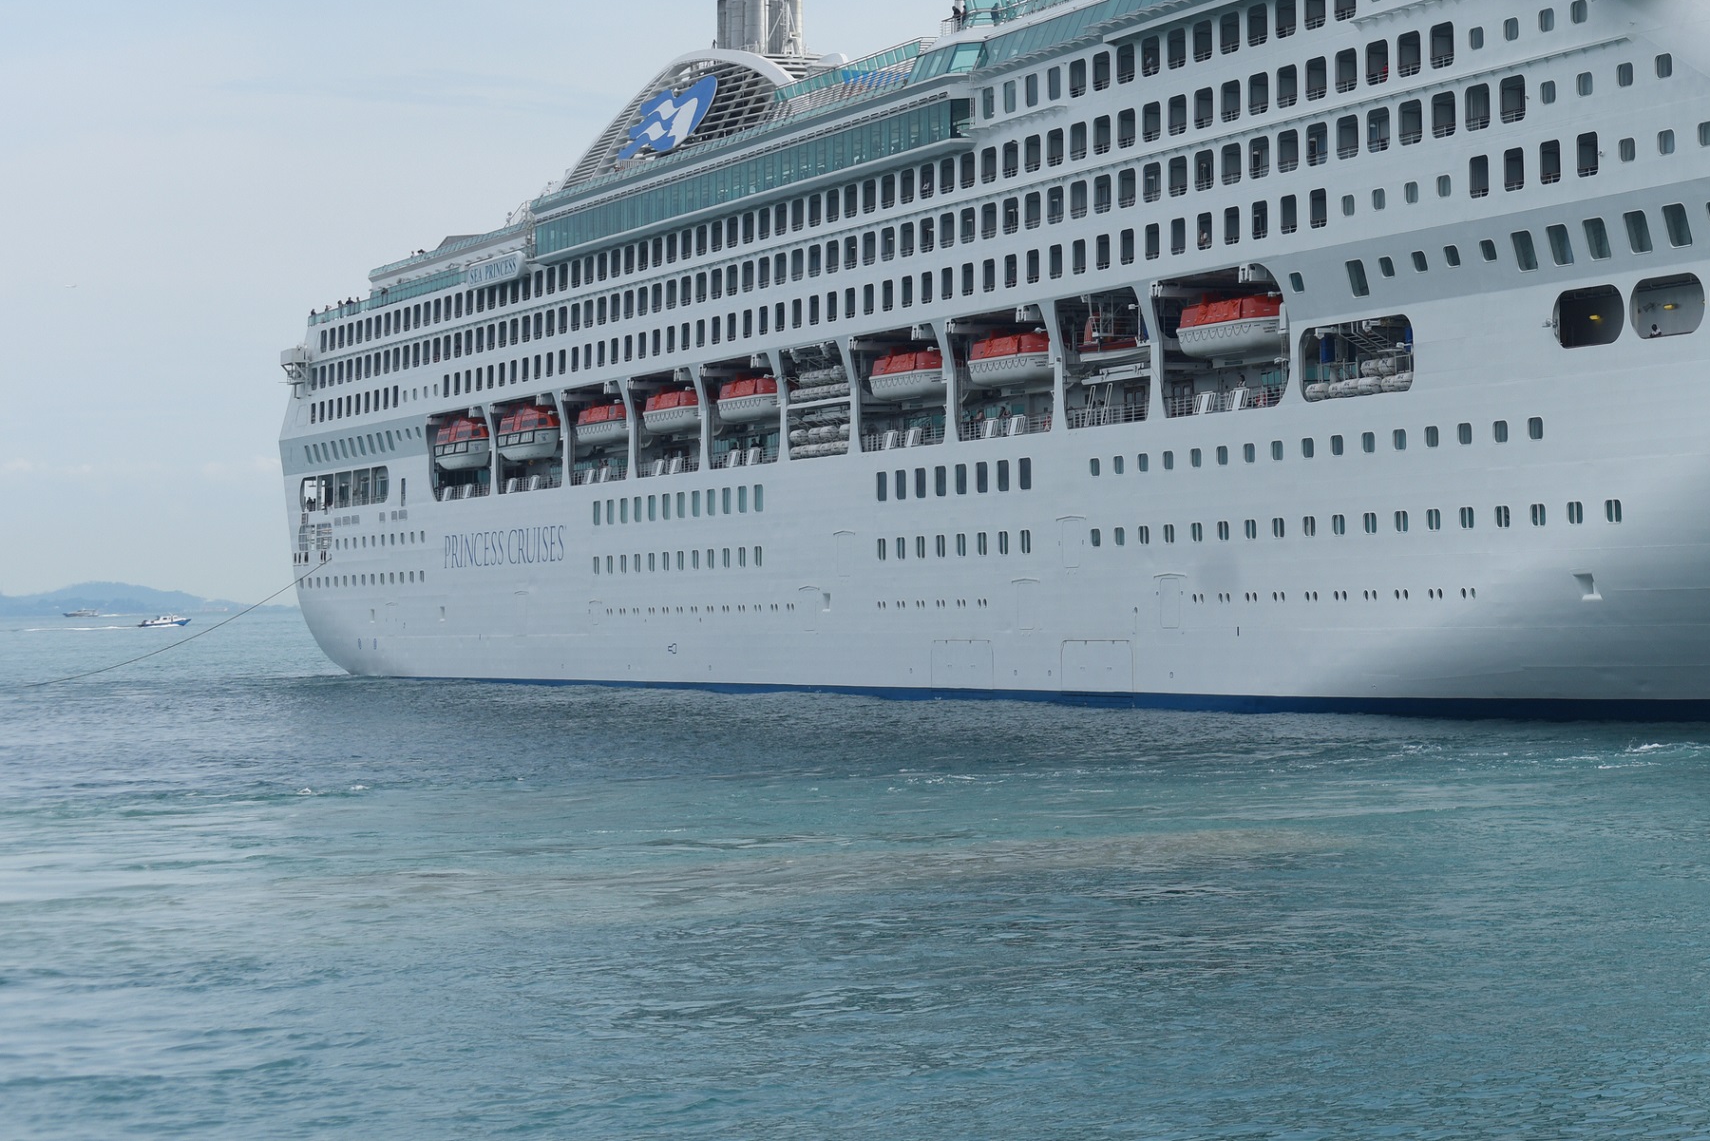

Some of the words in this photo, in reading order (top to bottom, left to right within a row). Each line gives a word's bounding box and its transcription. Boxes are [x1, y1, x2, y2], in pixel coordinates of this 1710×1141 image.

[470, 268, 483, 285] SEA
[485, 257, 517, 280] PRINCESS
[444, 531, 505, 569] PRINCESS
[507, 524, 565, 565] CRUISES
